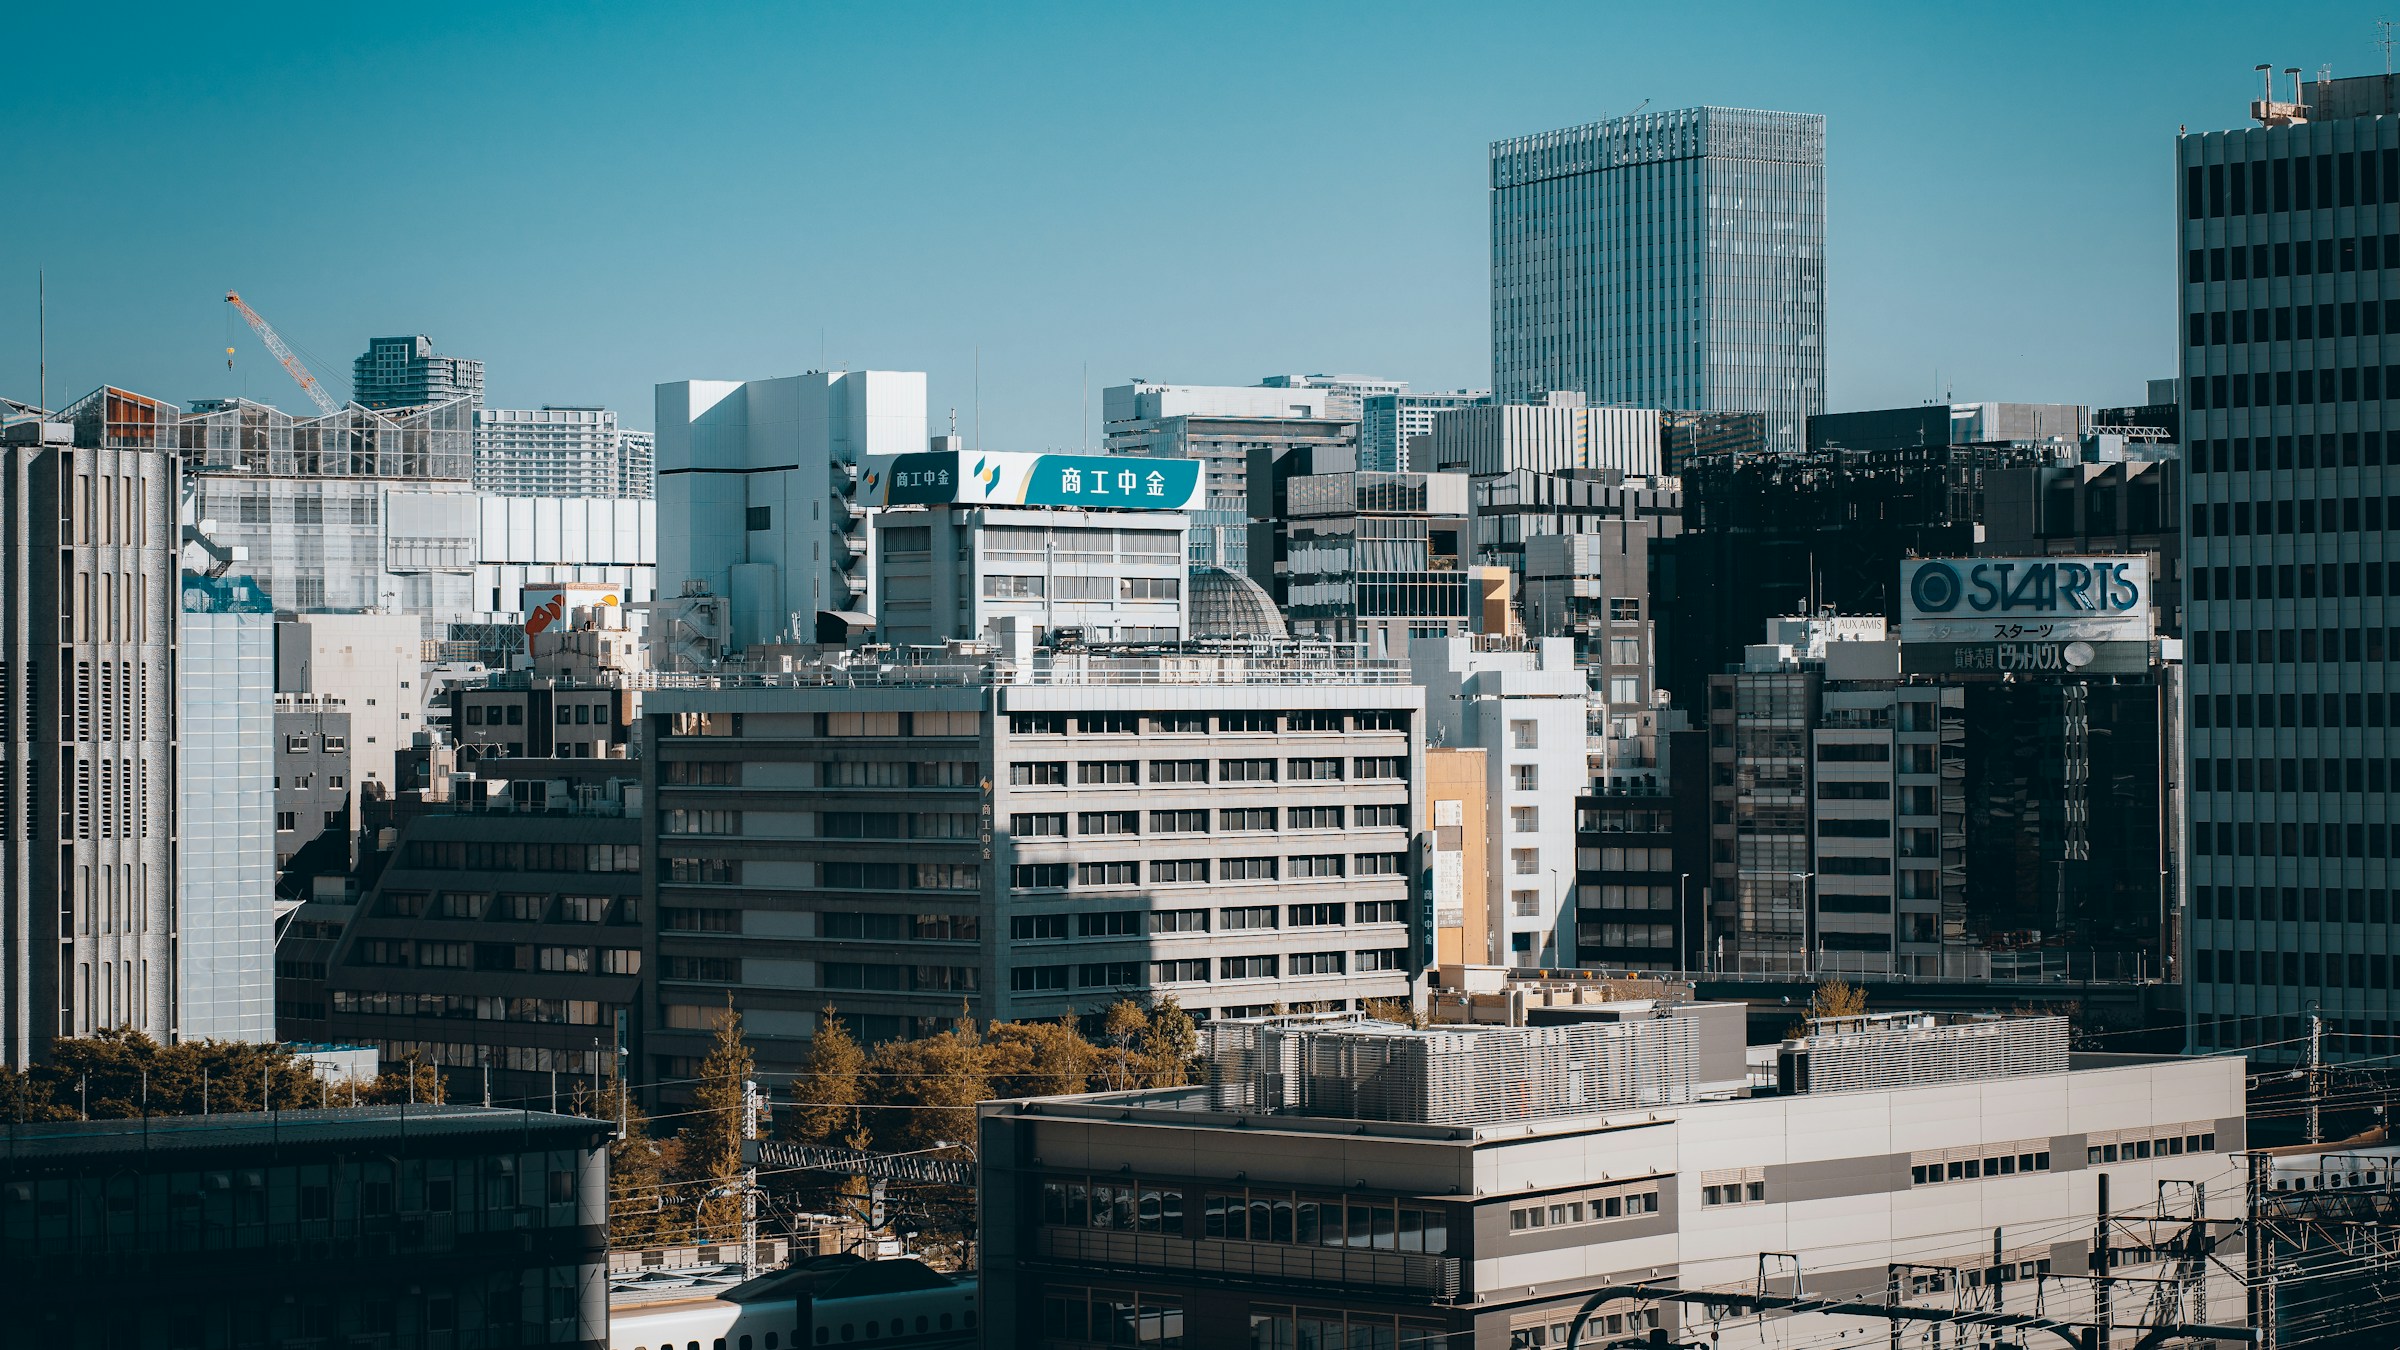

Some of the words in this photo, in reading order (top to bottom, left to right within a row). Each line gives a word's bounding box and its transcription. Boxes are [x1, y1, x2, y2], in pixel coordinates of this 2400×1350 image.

[896, 469, 949, 488] 商工中金
[1061, 467, 1165, 497] 商工中金
[1839, 619, 1858, 629] AUX
[1860, 619, 1882, 629] AMIS
[1993, 624, 2054, 639] スターツ
[1998, 642, 2062, 670] ピタットハウス
[982, 803, 991, 860] 商工中金
[1423, 889, 1433, 945] 商工中金
